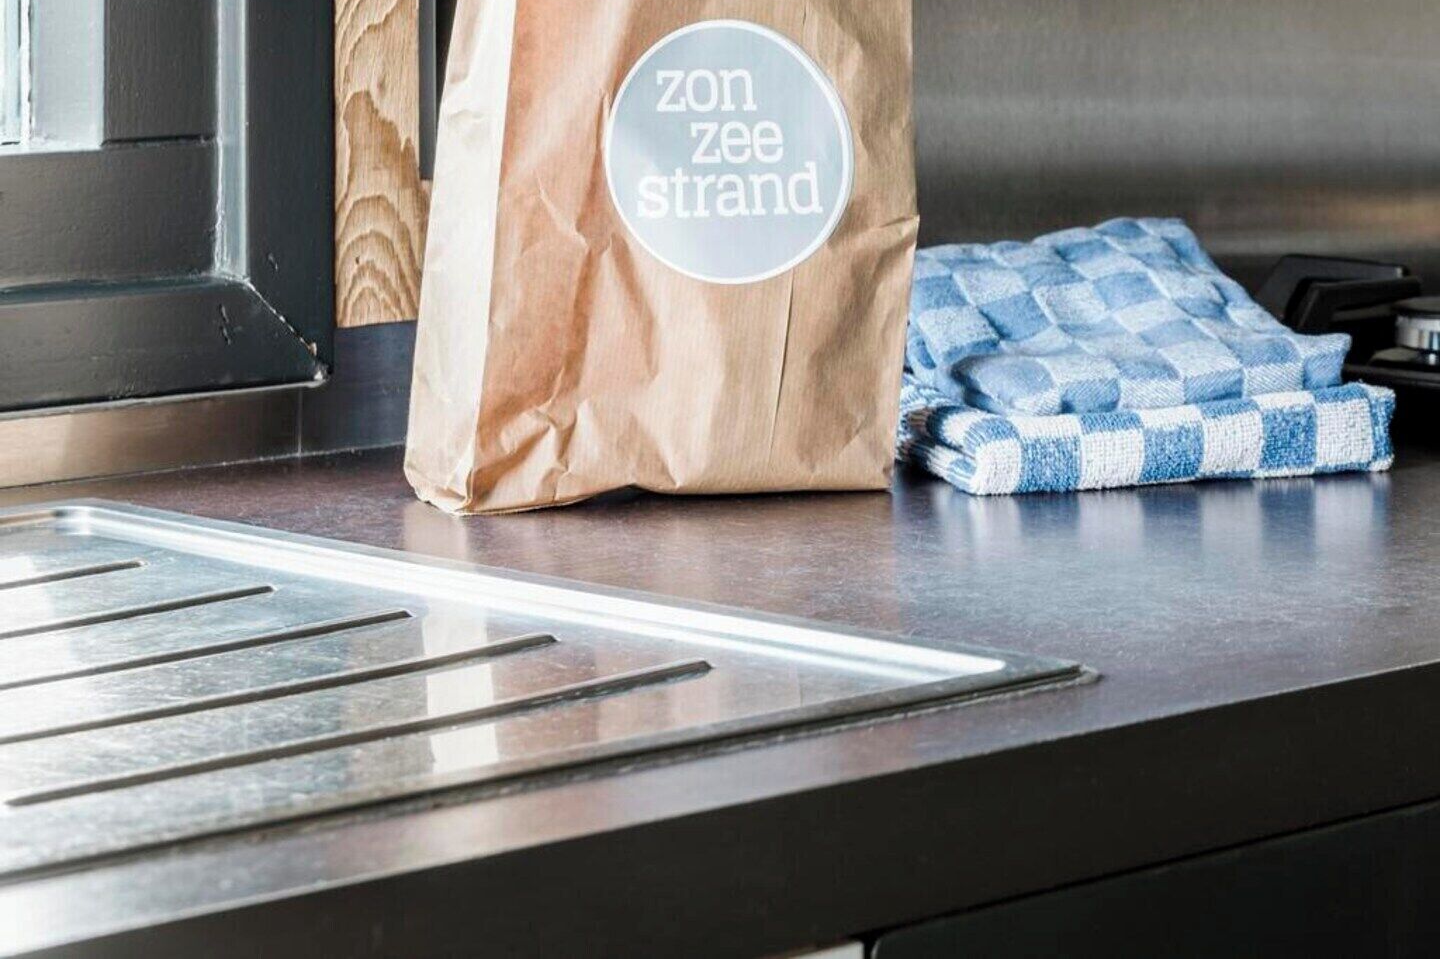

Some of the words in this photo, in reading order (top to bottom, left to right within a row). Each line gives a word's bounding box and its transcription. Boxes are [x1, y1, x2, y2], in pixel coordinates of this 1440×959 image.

[656, 68, 757, 112] zon
[690, 120, 784, 164] zee
[636, 161, 824, 219] strand
